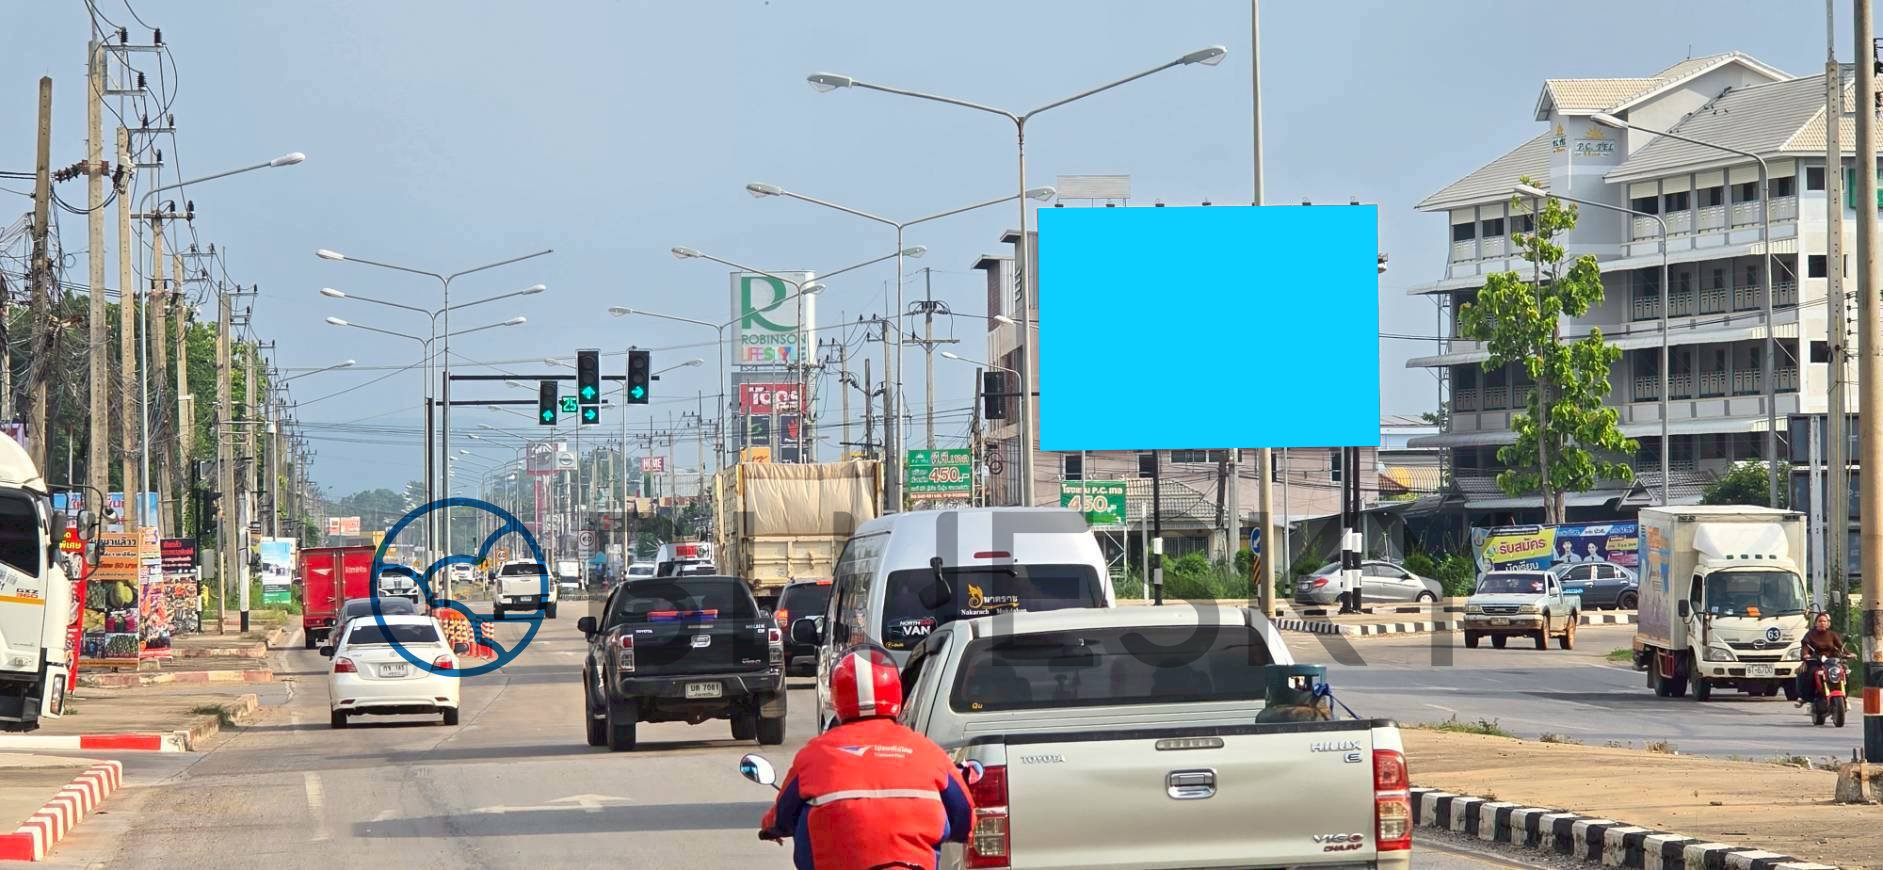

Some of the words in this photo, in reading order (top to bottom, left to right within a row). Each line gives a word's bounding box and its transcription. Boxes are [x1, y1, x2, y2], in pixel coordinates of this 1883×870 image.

[741, 334, 807, 345] ROBINSON
[563, 397, 577, 411] 25
[1499, 537, 1547, 555] รับสมัคร
[903, 625, 931, 636] VAN
[1767, 629, 1780, 639] 63
[1311, 741, 1361, 752] HILUX
[1020, 754, 1065, 764] TOYOTA
[1344, 752, 1362, 763] E
[1313, 833, 1364, 844] VIGO
